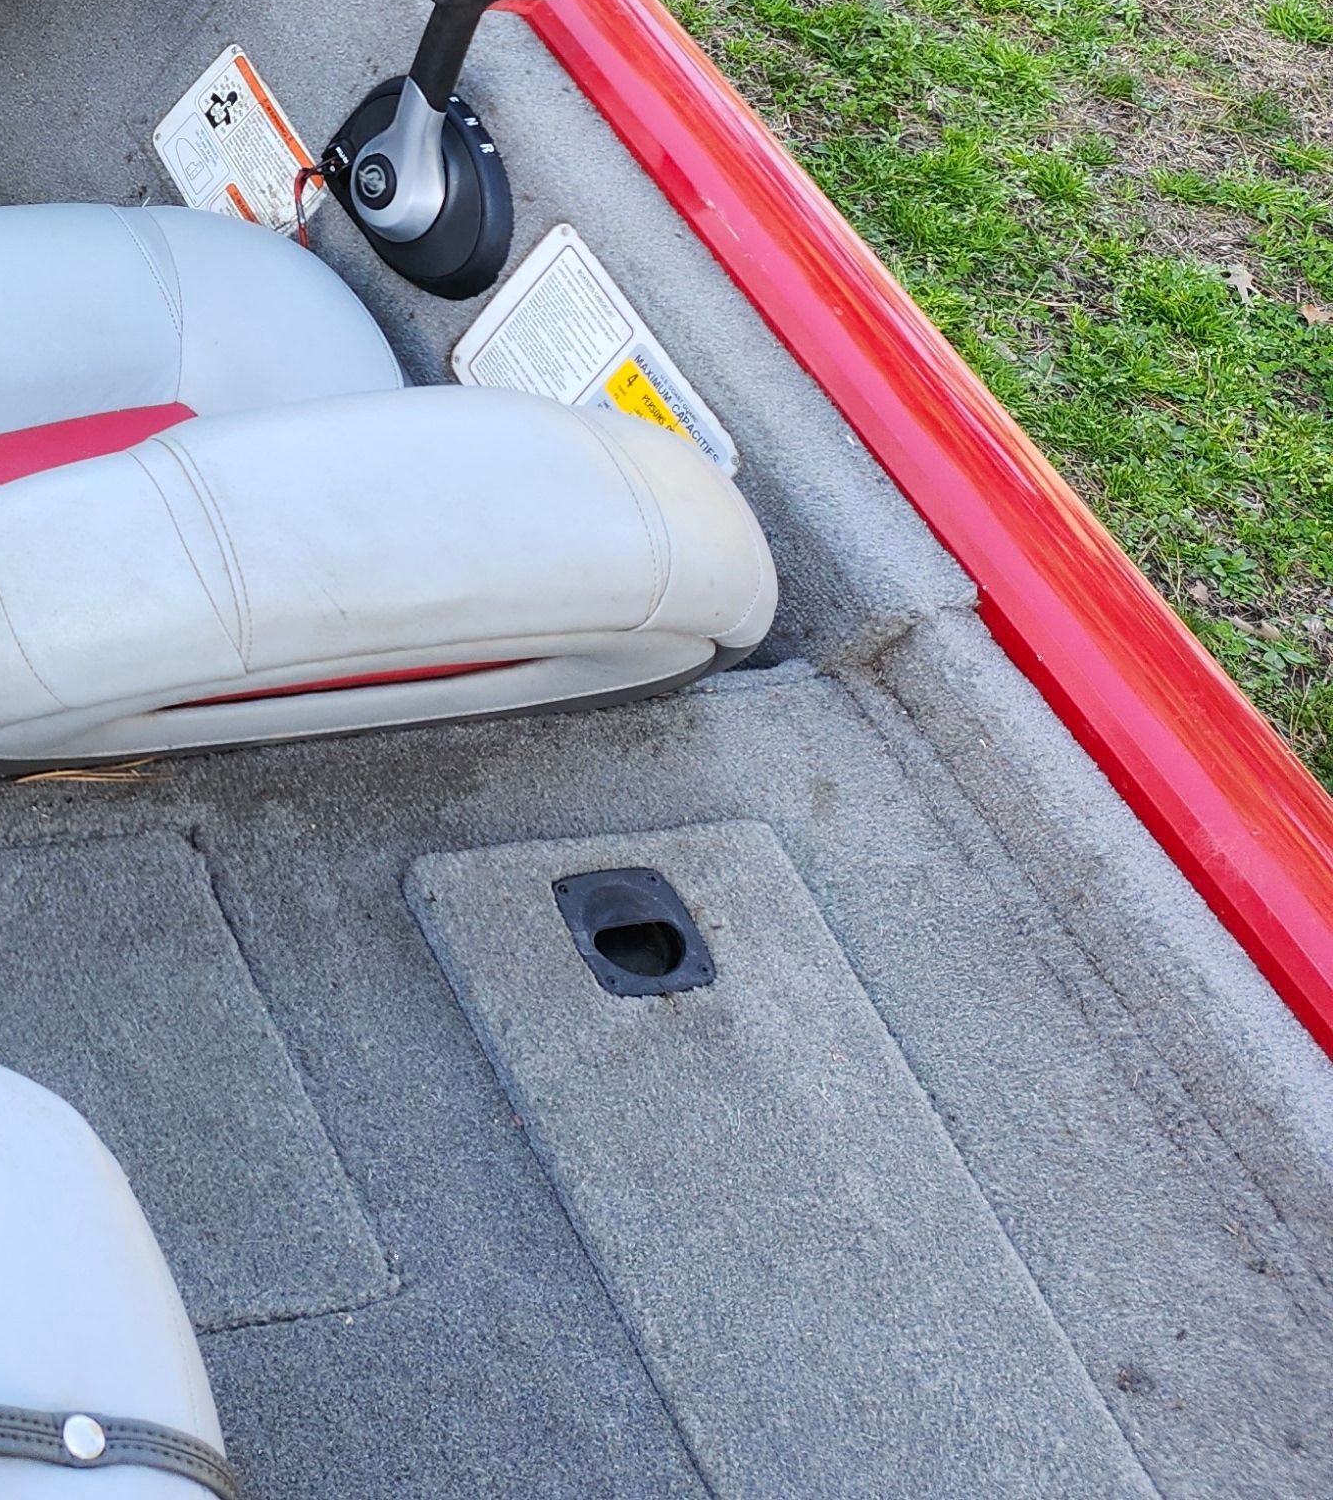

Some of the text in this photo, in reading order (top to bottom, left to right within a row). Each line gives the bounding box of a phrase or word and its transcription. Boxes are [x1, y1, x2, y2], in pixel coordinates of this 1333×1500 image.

[463, 117, 479, 127] N
[479, 143, 495, 154] R
[626, 373, 667, 426] 4 PERSONS
[634, 354, 720, 463] MAXIMUM CAPACITIES
